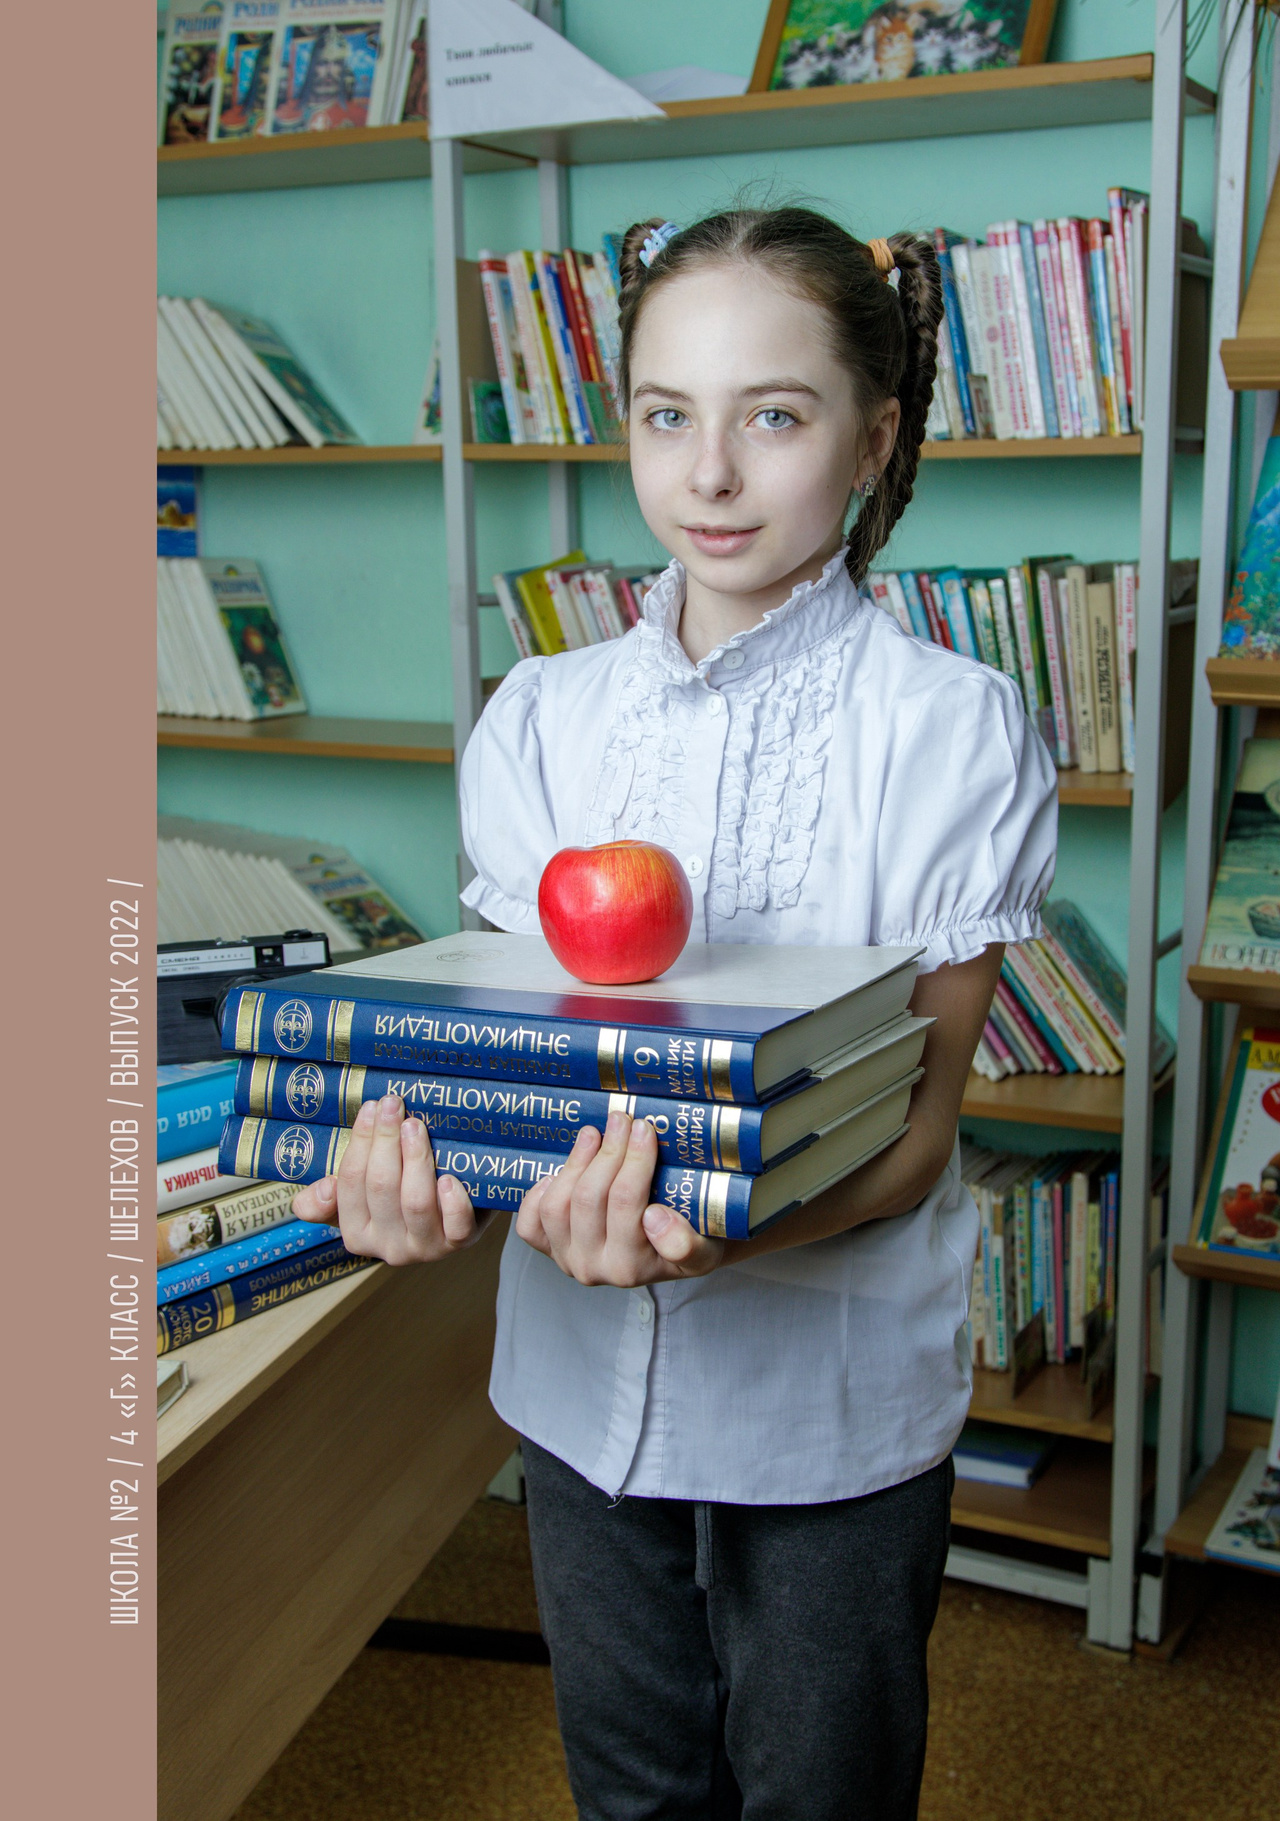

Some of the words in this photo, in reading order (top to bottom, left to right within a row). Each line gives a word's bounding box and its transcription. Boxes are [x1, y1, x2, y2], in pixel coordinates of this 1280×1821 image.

[374, 1013, 571, 1057] ЭНЦИКЛОПЕДИЯ
[374, 1042, 482, 1069] РОССИЙСКАЯ
[488, 1055, 571, 1078] БОЛЬШАЯ
[634, 1046, 661, 1082] 19
[666, 1038, 684, 1095] МАНИК
[681, 1040, 699, 1096] МЕОТИ
[387, 1079, 581, 1122] ЭНЦИКЛОПЕДИЯ
[675, 1103, 691, 1165] ЛОМОН
[690, 1106, 706, 1165] МАНИЗ
[163, 1273, 211, 1298] БАЙКАЛ
[248, 1264, 303, 1292] БОЛЬШАЯ
[192, 1302, 213, 1333] 20
